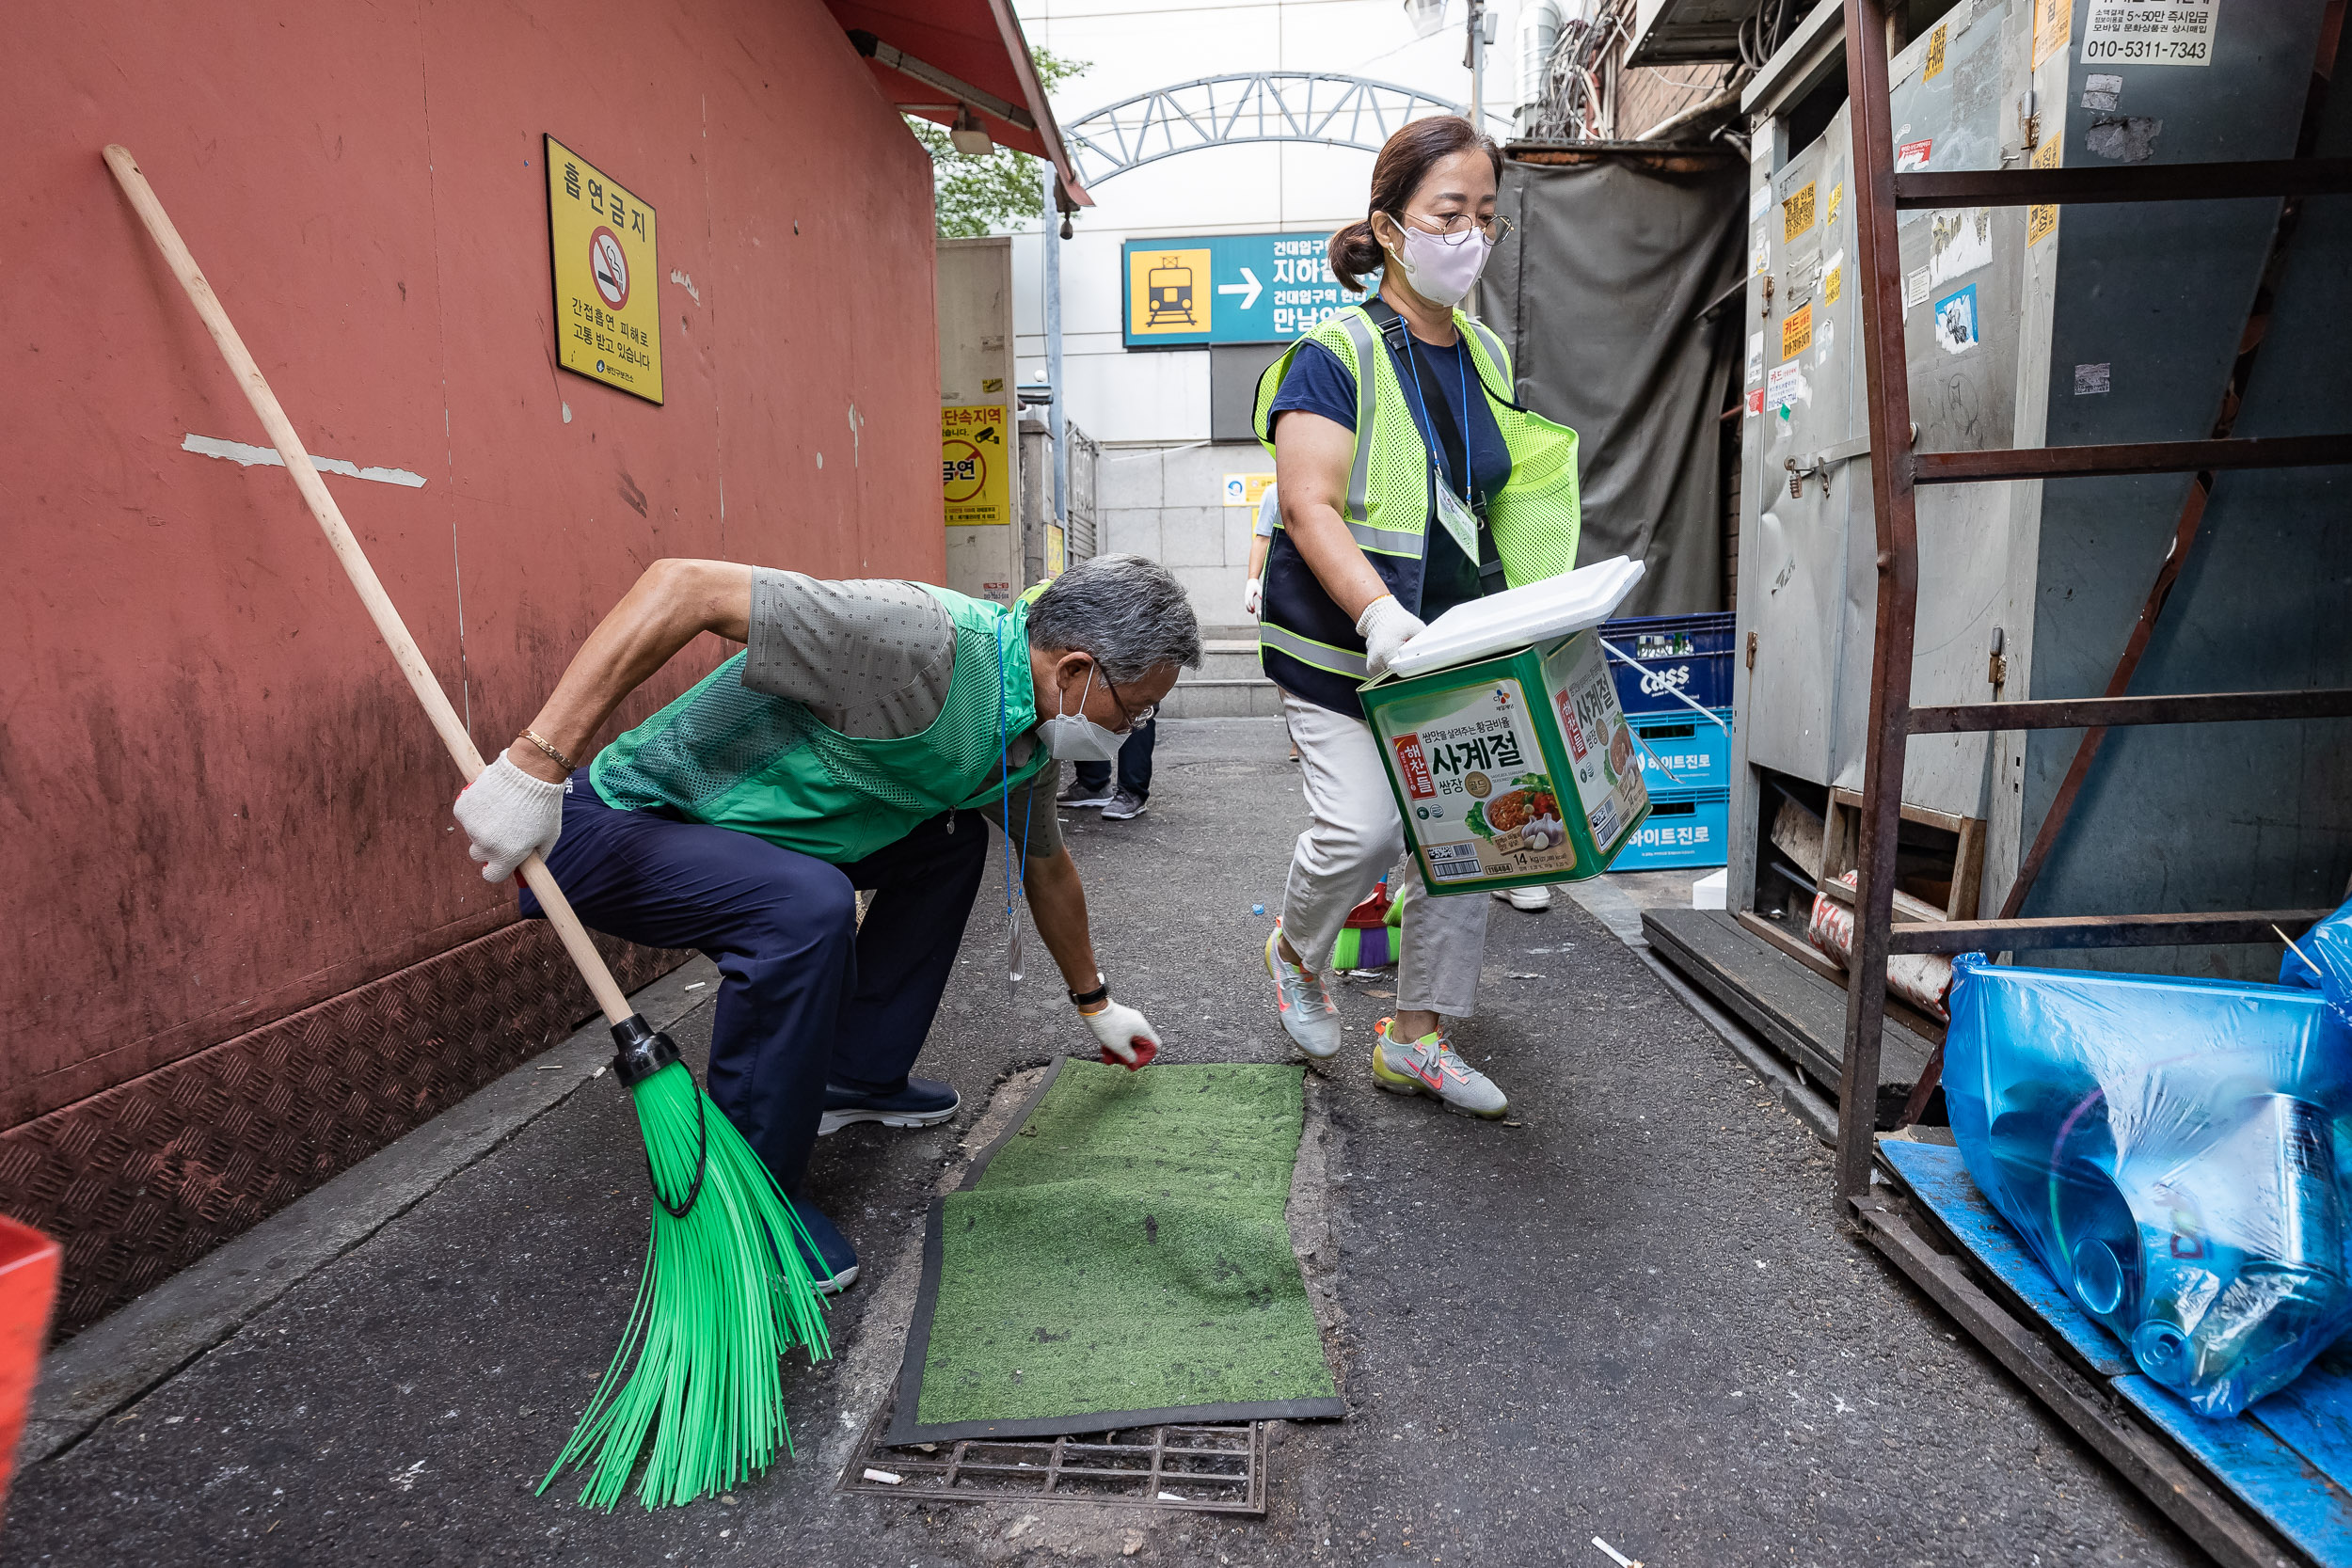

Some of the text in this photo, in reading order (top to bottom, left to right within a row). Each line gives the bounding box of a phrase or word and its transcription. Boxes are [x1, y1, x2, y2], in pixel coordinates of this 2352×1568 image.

[2126, 10, 2209, 24] 5~50만 즉시입금
[2123, 24, 2169, 33] 문화상품권
[2172, 24, 2207, 33] 상시매입
[2088, 40, 2207, 58] 010-5311-7343
[564, 162, 645, 243] 흡연금지
[1274, 240, 1329, 256] 건대입구
[1274, 289, 1337, 305] 건대입구역
[572, 297, 649, 347] 간접흡연 피해로
[1785, 316, 1799, 336] 카드
[574, 323, 651, 372] 고통 받고 있습니다
[1770, 371, 1783, 384] 카드
[943, 459, 976, 481] 금연
[1577, 673, 1613, 730] 사계절
[1432, 730, 1524, 776] 사계절
[1648, 753, 1711, 771] 하이트진로
[1405, 744, 1433, 794] 해찬들
[1438, 777, 1464, 796] 쌈장
[1629, 826, 1710, 847] 하이트진로
[1514, 853, 1528, 865] 14
